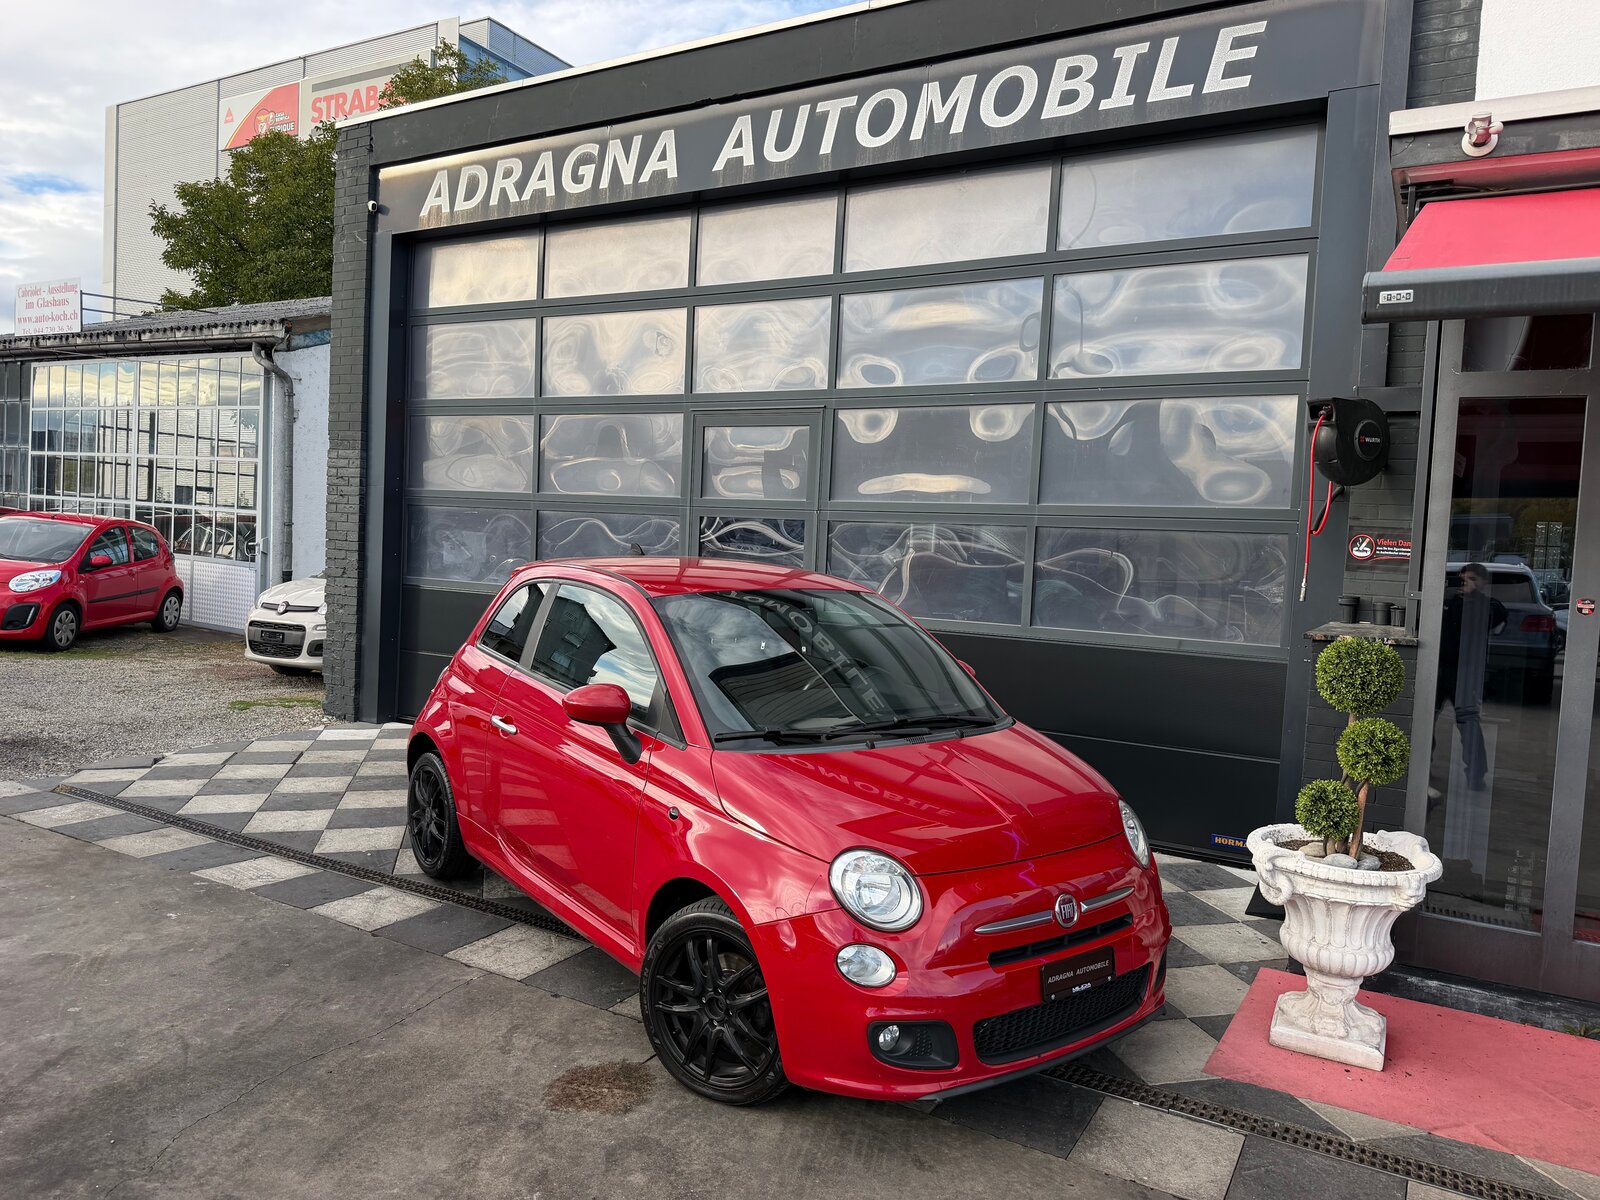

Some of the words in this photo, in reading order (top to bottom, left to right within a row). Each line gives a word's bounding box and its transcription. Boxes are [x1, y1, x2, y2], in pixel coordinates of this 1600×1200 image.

[311, 82, 406, 123] STRAB
[420, 128, 680, 217] ADRAGNA
[711, 20, 1268, 173] AUTOMOBILE
[17, 285, 42, 298] Cabriolet
[48, 282, 78, 295] Ausstellung
[25, 299, 34, 309] im
[36, 297, 69, 309] Glashaus
[17, 310, 78, 324] www.auto-koch.ch
[1061, 903, 1074, 919] FIAT
[1048, 971, 1074, 984] ADRAGNA
[1075, 960, 1110, 976] AUTOMOBILE
